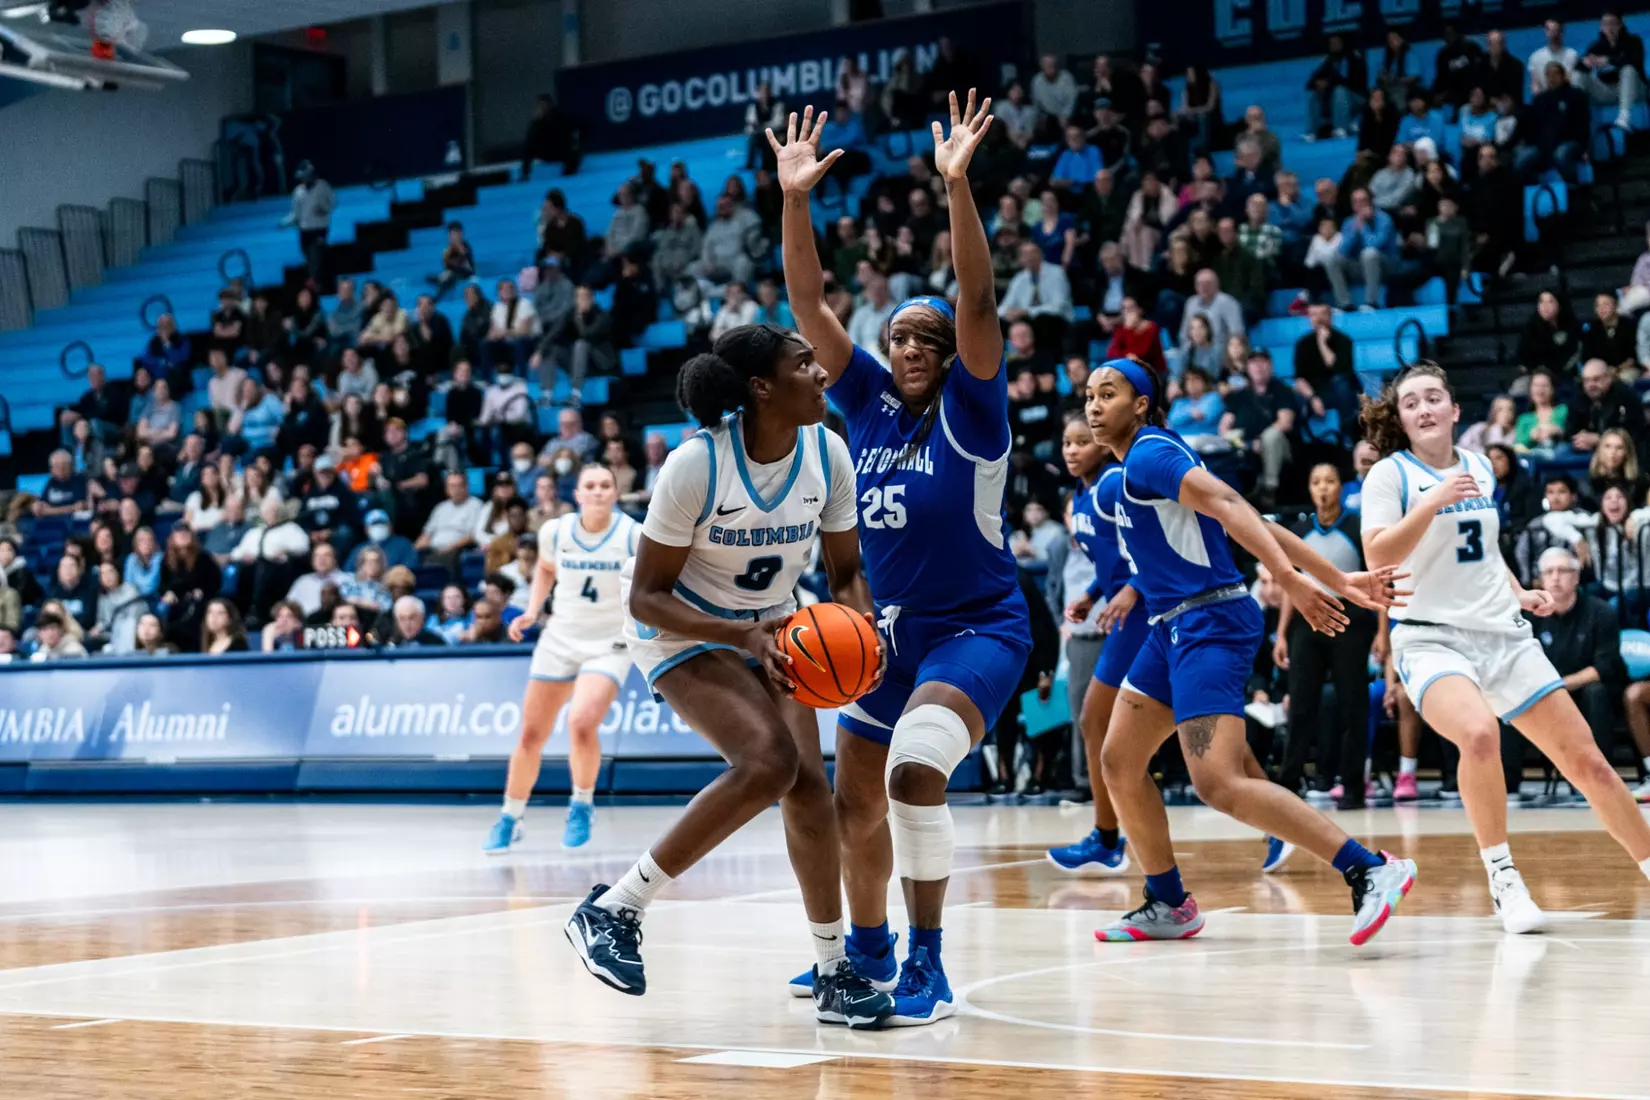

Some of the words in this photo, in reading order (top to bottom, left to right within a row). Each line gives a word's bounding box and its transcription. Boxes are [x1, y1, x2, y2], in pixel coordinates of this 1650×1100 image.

[861, 484, 908, 530] 25
[1456, 519, 1485, 564] 3
[580, 575, 599, 603] 4
[303, 626, 348, 649] POSS
[108, 699, 232, 743] Alumni
